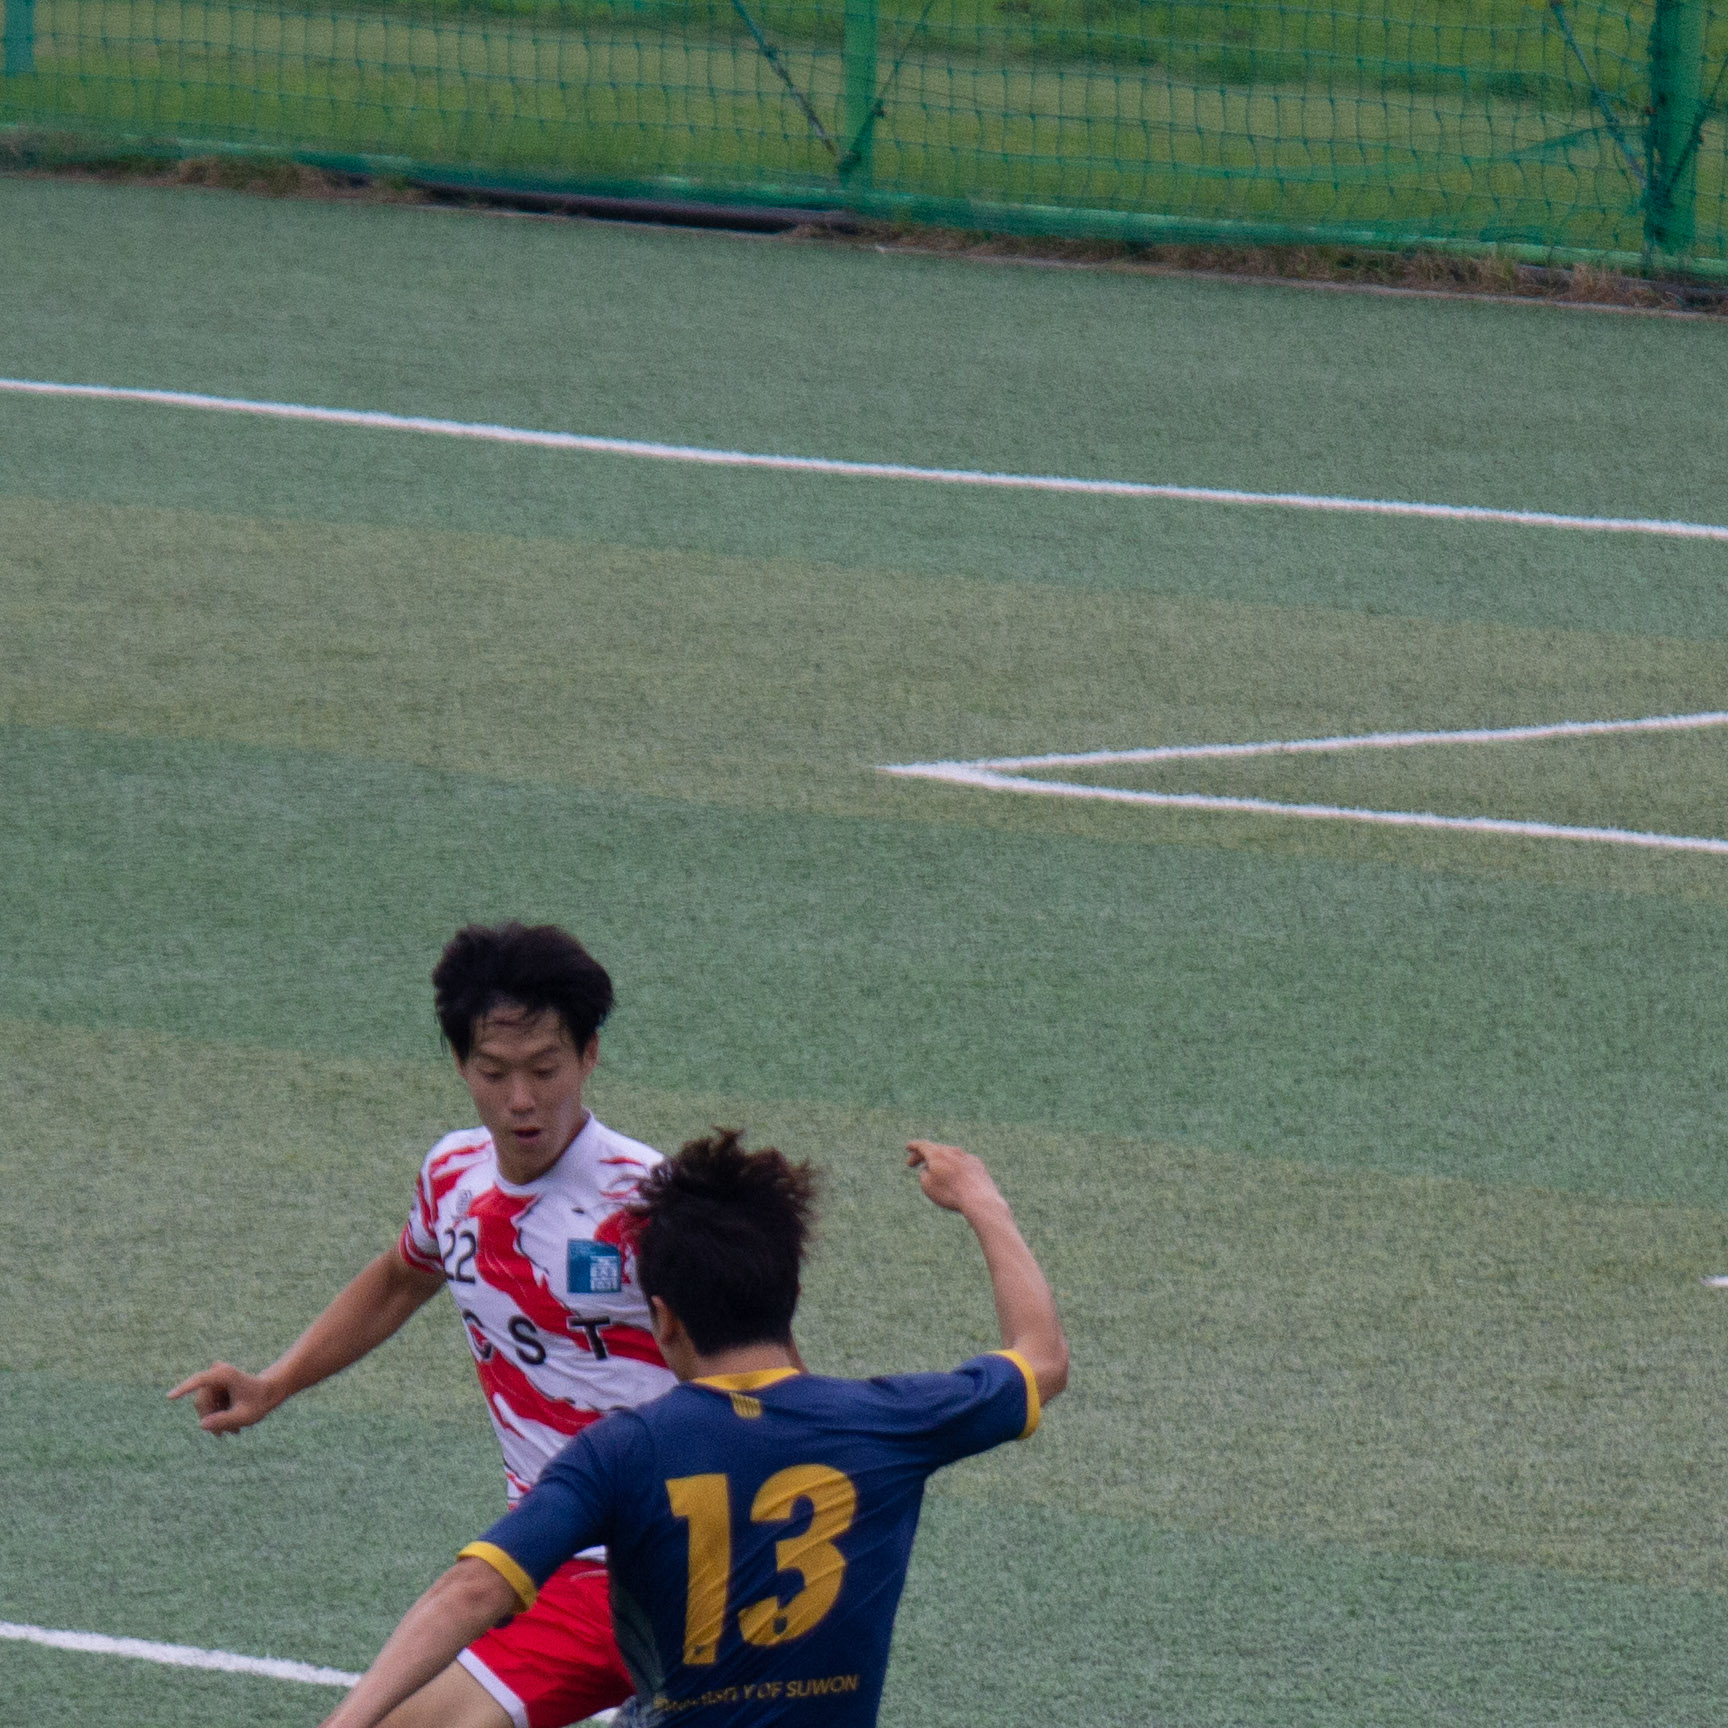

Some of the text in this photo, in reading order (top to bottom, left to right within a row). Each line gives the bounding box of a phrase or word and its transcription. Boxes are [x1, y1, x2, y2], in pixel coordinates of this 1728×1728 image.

[440, 1228, 476, 1284] 22
[665, 1463, 858, 1666] 13
[786, 1674, 860, 1698] SUWON
